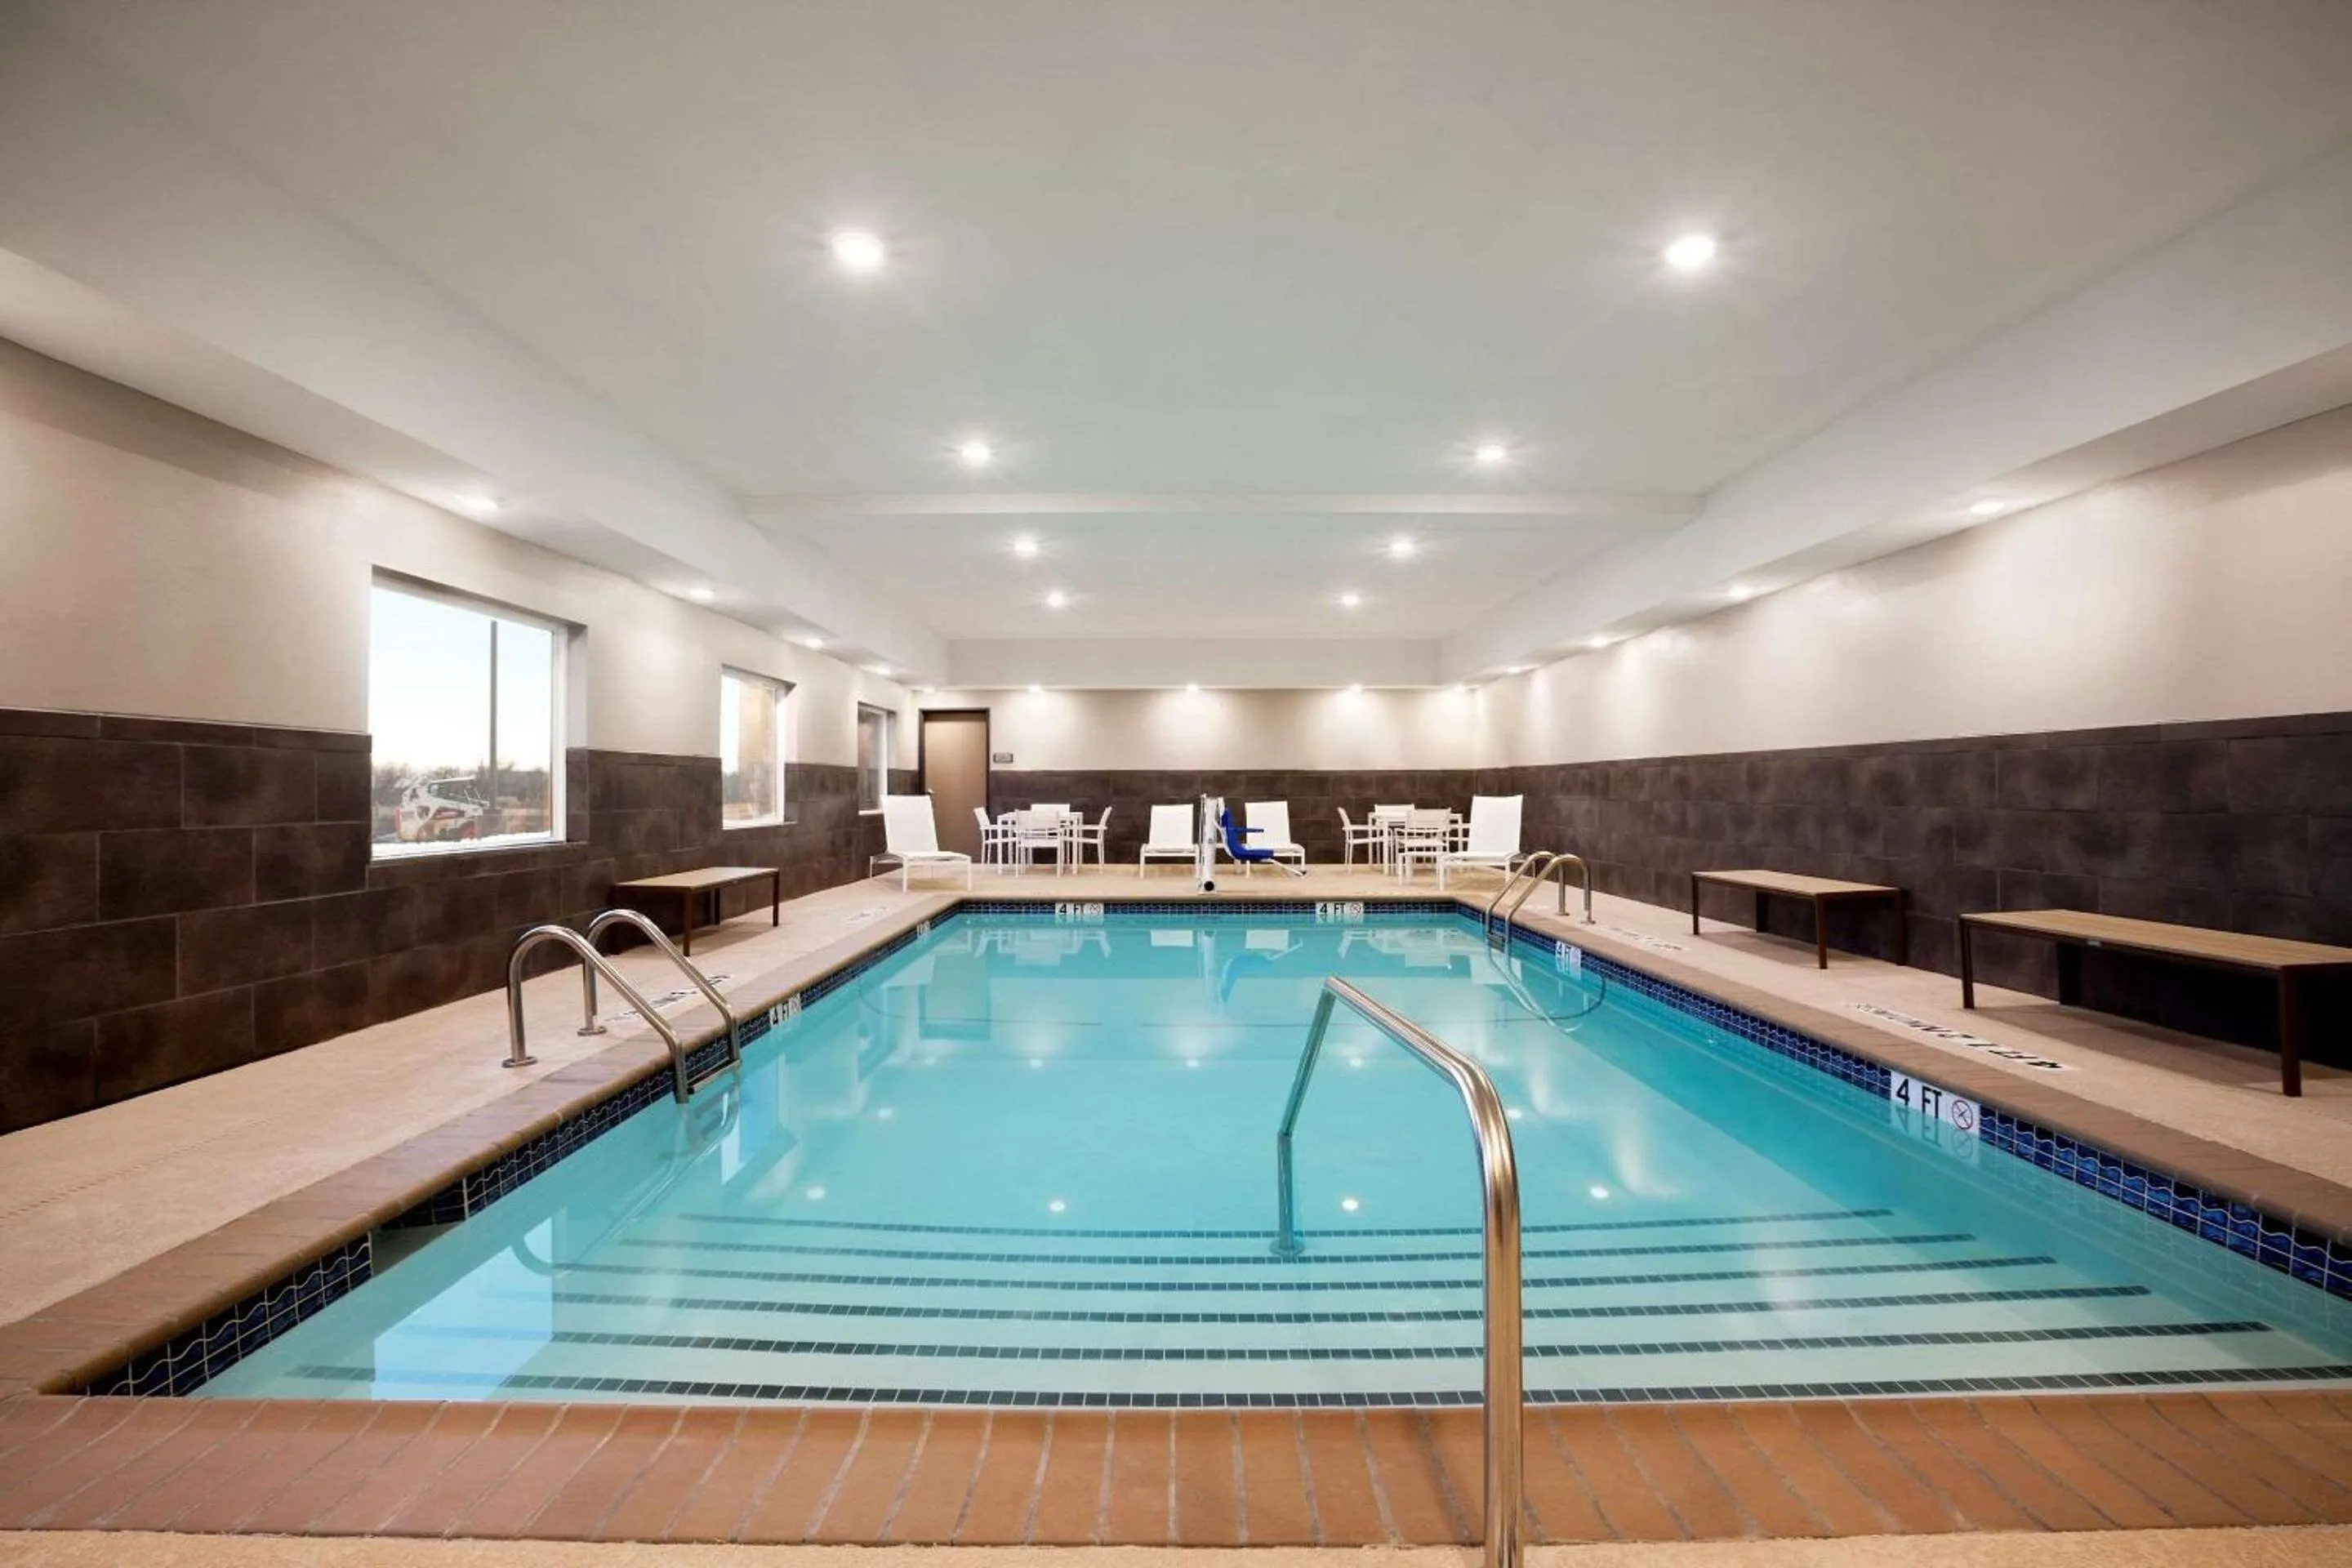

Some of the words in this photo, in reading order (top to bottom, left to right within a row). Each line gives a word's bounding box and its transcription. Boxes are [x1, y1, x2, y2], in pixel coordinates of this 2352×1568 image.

[1059, 903, 1067, 914] 4
[1073, 903, 1085, 915] FT
[1320, 903, 1327, 914] 4
[1334, 902, 1346, 915] FT
[1896, 1078, 1909, 1106] 4
[1922, 1084, 1942, 1120] FT
